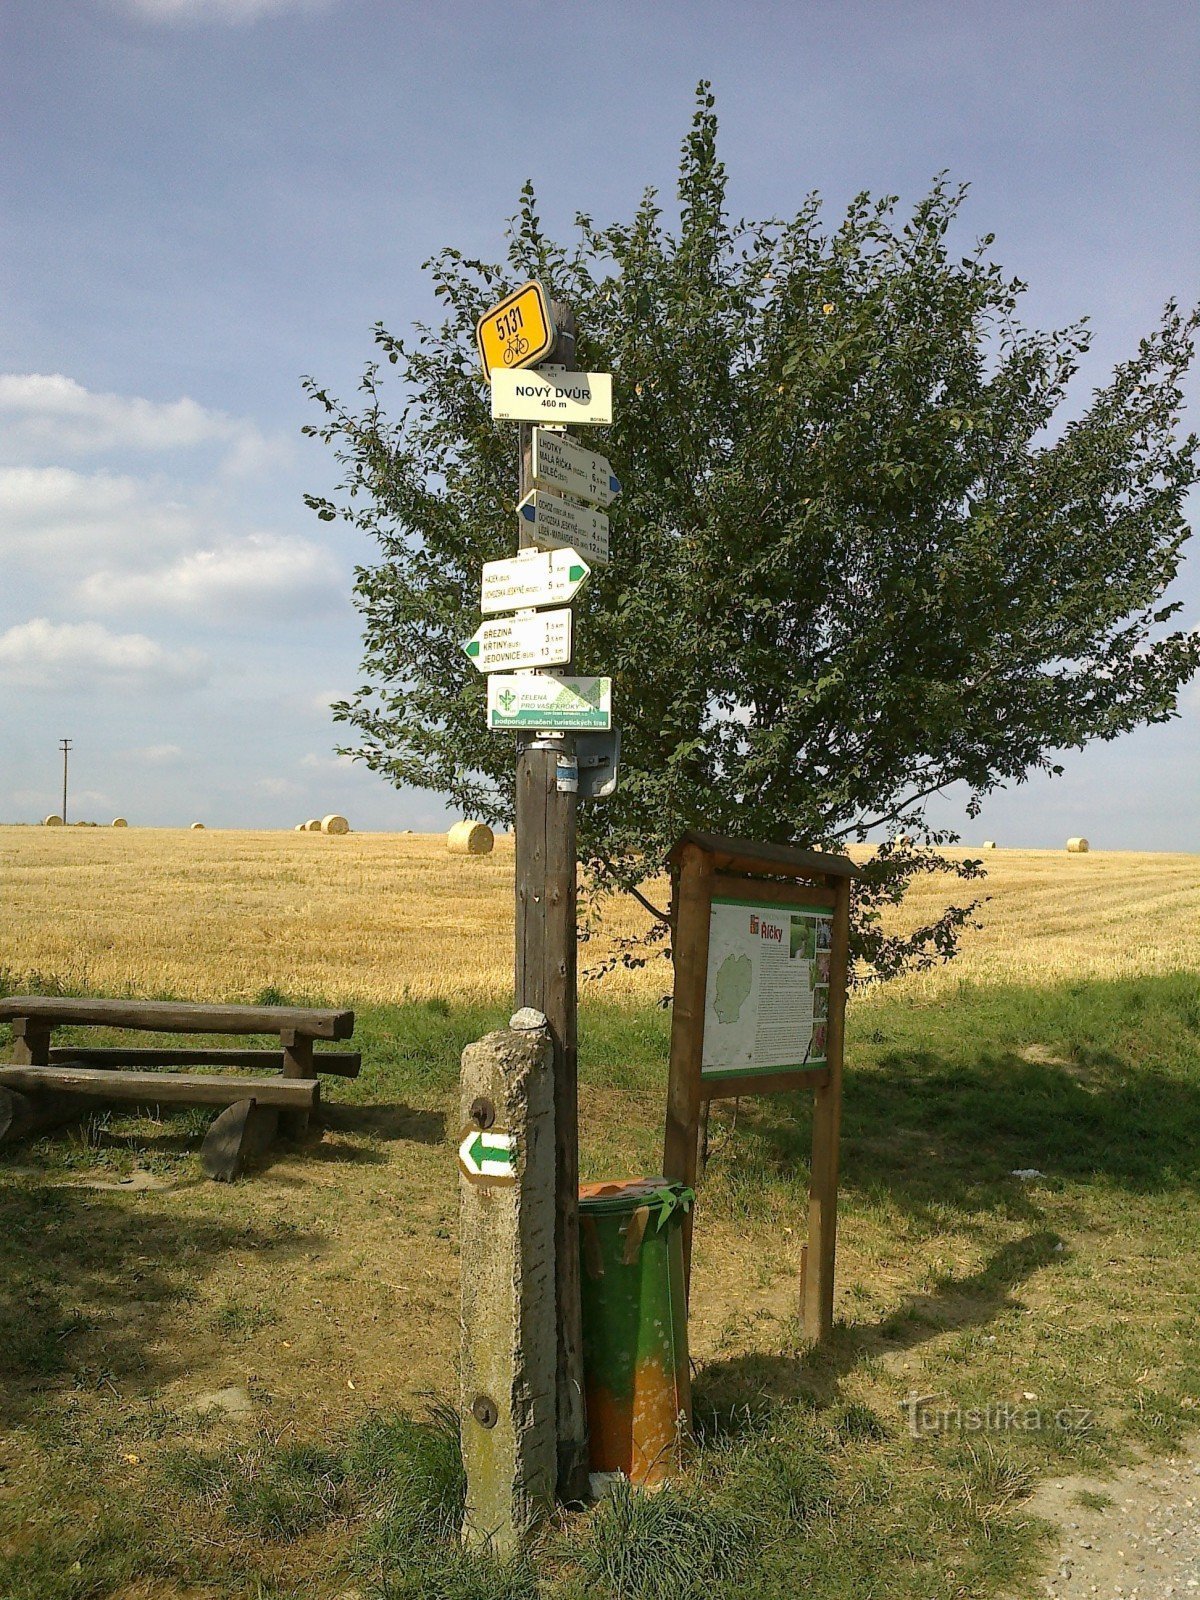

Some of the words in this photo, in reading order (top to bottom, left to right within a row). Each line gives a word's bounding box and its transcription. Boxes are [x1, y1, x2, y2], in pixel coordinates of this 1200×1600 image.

[496, 306, 524, 341] 5131
[516, 385, 552, 397] NOVÝ
[555, 386, 591, 399] DVŮR
[541, 400, 557, 408] 460
[591, 461, 596, 470] 2
[589, 484, 597, 493] 17
[592, 519, 597, 528] 3
[548, 581, 553, 590] 5
[483, 627, 512, 639] BŘEZINA
[483, 641, 507, 651] KŘTINY
[483, 650, 520, 664] JEDOVNICE
[541, 647, 550, 656] 13
[494, 718, 527, 726] podporují
[554, 719, 592, 727] turistických
[761, 921, 783, 943] Říčky
